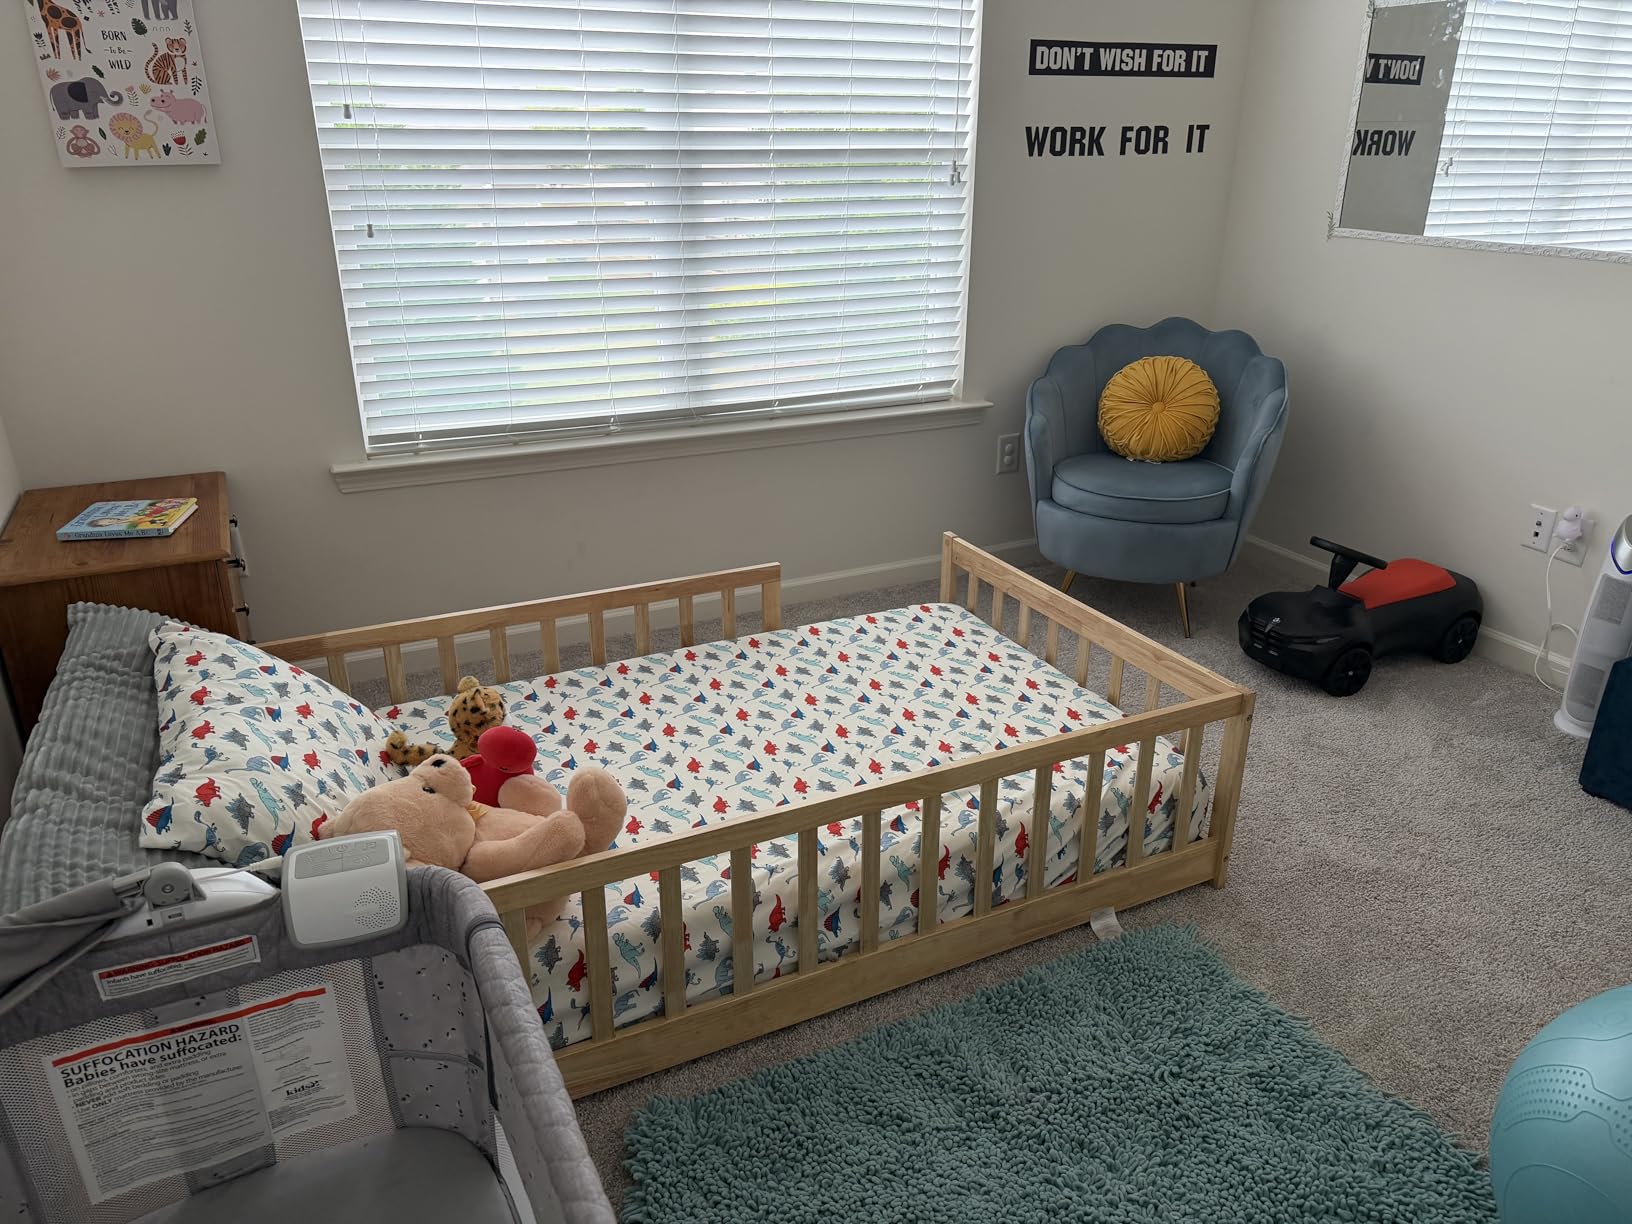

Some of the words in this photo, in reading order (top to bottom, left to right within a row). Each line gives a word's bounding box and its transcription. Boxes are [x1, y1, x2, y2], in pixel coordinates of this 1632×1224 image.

[101, 30, 127, 41] BORN
[108, 59, 131, 70] WILD
[1035, 46, 1094, 70] DON'T
[1100, 48, 1147, 72] WISH
[1152, 50, 1186, 72] FOR
[1191, 51, 1209, 72] IT
[1025, 126, 1107, 157] WORK
[1119, 125, 1169, 155] FOR
[1185, 124, 1210, 153] IT
[60, 1040, 172, 1079] SUFFOCATION
[175, 1024, 239, 1048] HAZARD
[63, 1066, 117, 1088] Babies
[120, 1056, 156, 1070] have
[160, 1033, 242, 1062] suffocated:
[75, 1096, 102, 1108] NEVER
[92, 1098, 113, 1108] ONLY
